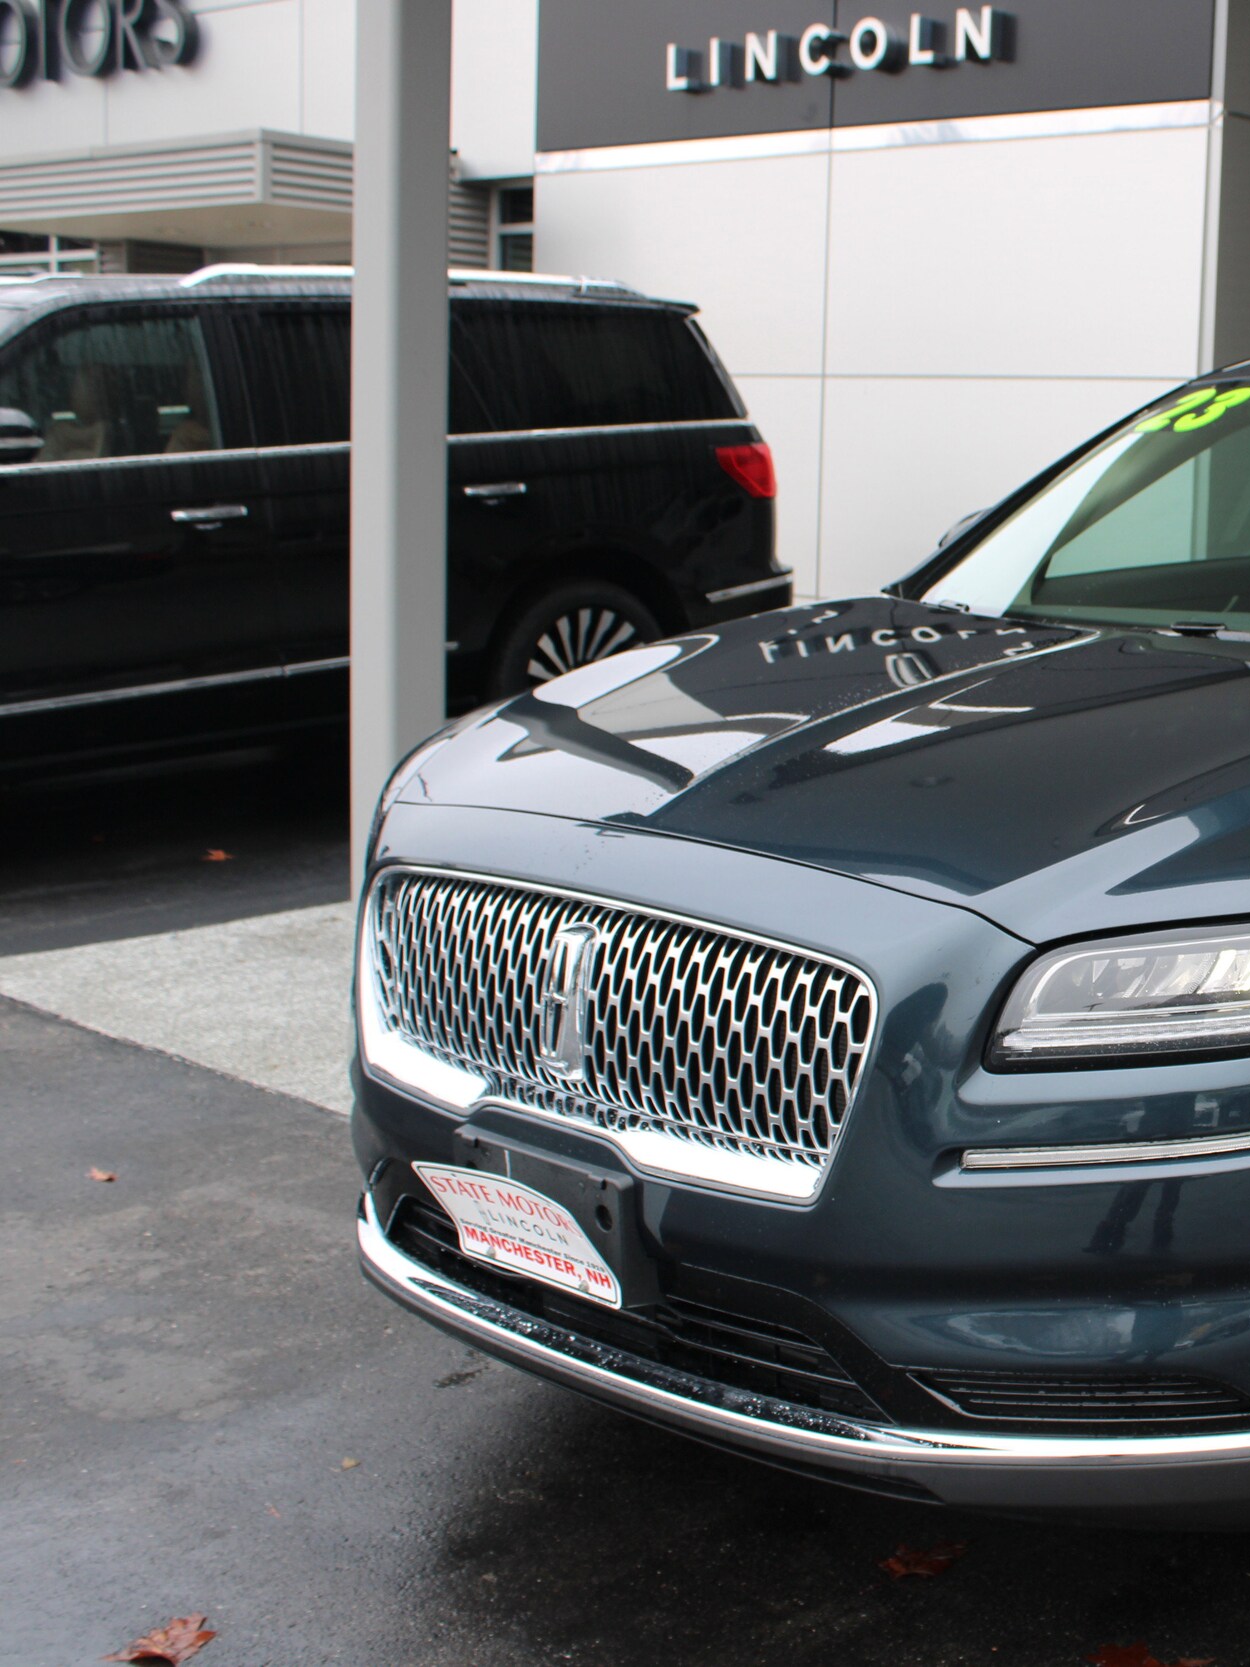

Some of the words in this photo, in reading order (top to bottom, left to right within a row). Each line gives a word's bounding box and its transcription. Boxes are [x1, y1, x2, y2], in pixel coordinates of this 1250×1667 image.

[666, 5, 993, 91] LINCOLN
[430, 1175, 495, 1204] STATE
[496, 1189, 583, 1239] MOTORS
[488, 1209, 569, 1246] LINCOLN
[463, 1225, 582, 1281] MANCHESTER,
[584, 1267, 612, 1291] NH
